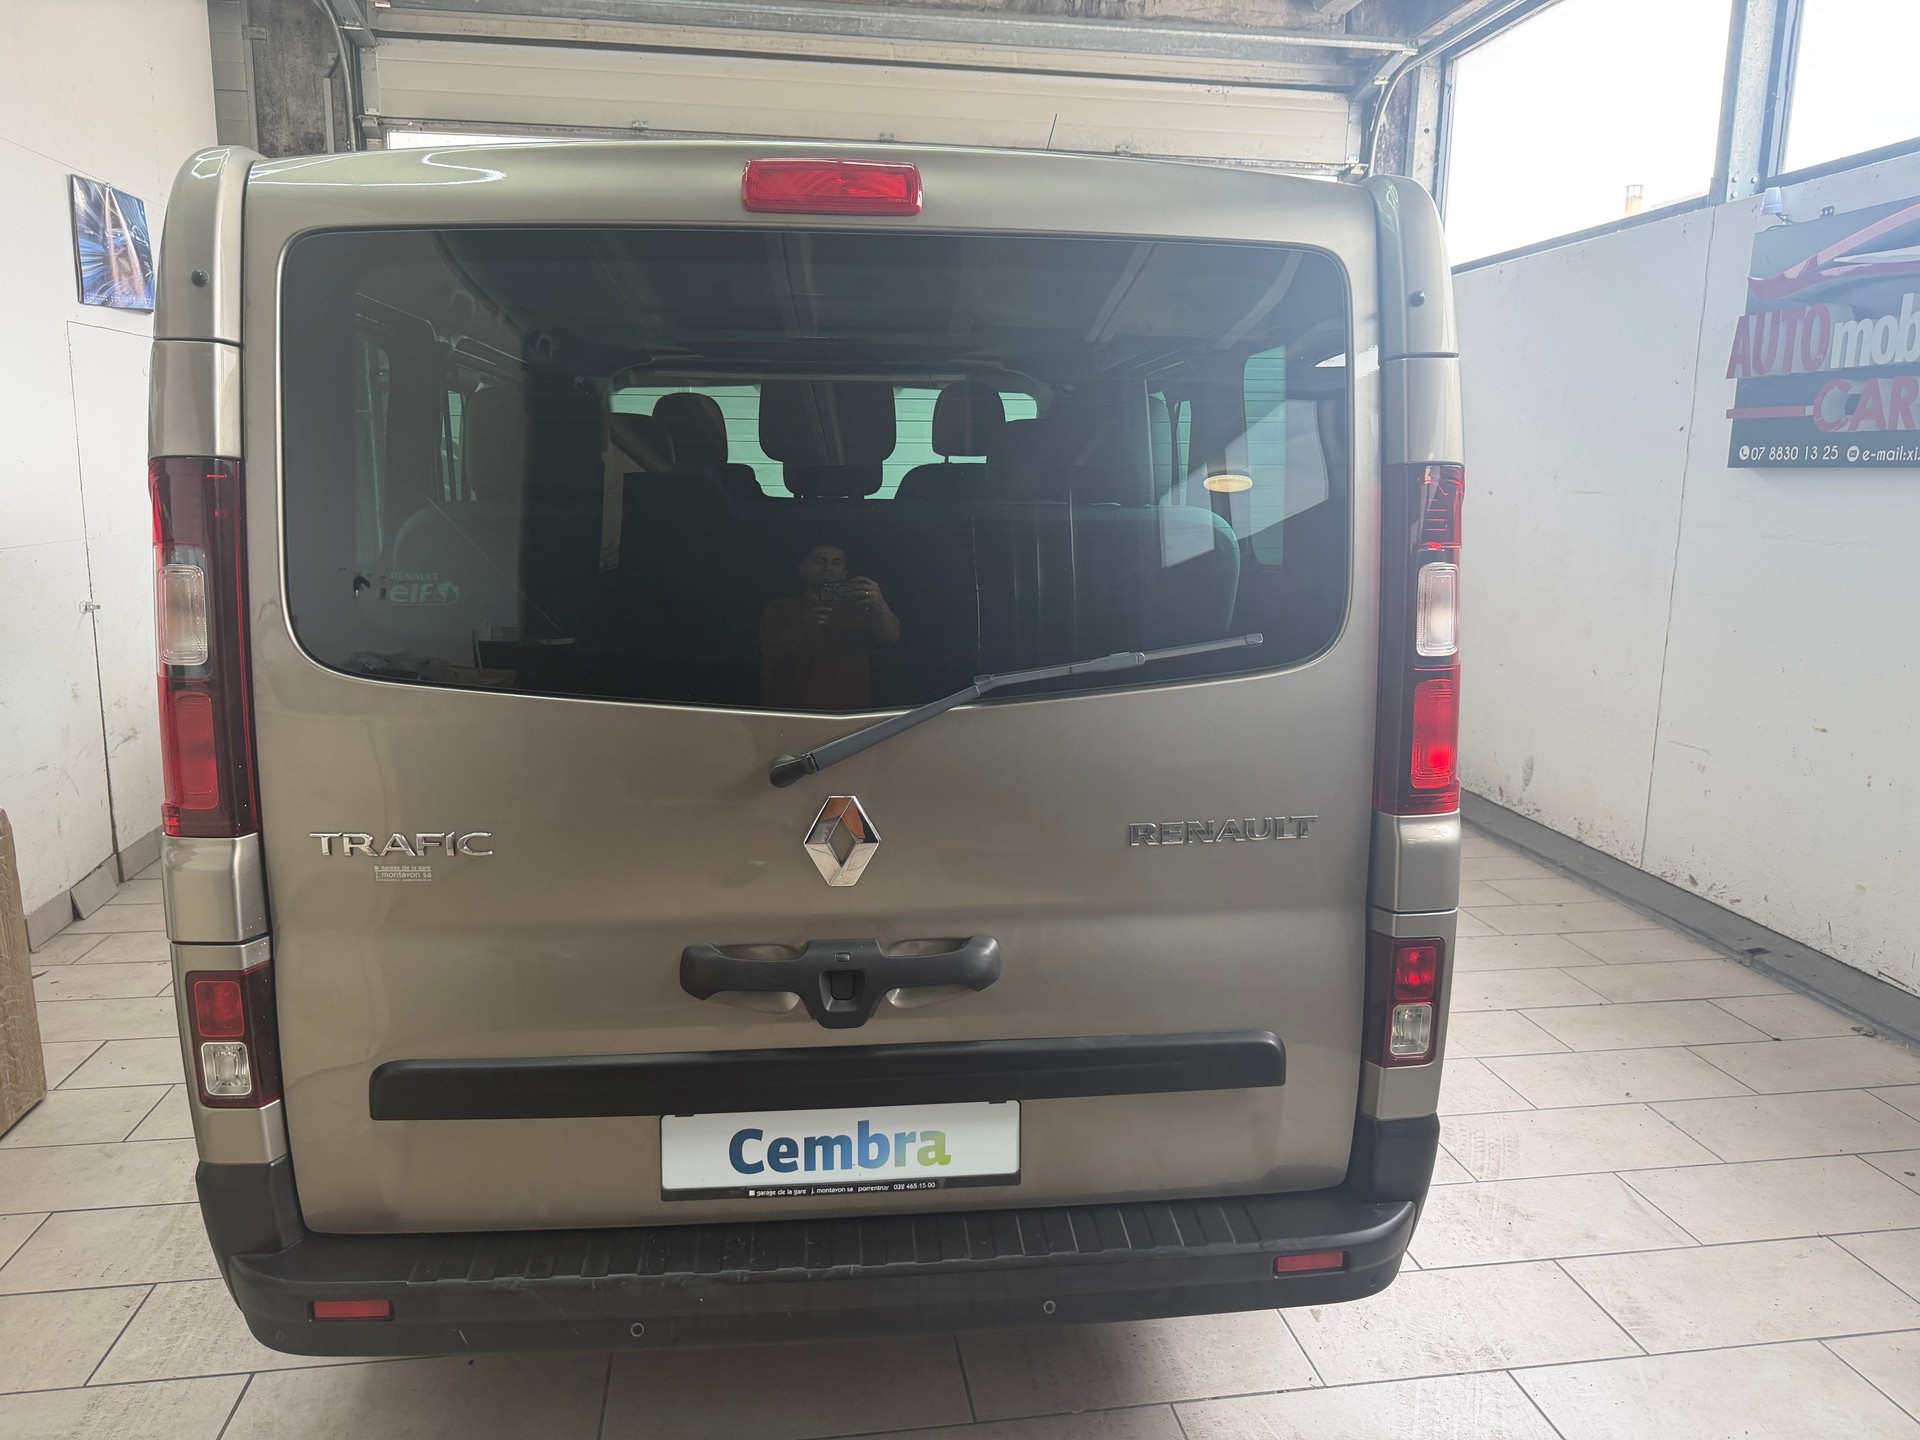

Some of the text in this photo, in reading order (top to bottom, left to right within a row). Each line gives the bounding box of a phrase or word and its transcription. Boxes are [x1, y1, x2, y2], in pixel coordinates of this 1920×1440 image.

[1751, 446, 1765, 460] 07
[1769, 446, 1799, 460] 8830
[1805, 445, 1817, 460] 13
[1823, 445, 1839, 460] 25
[391, 572, 438, 581] RENAULT
[1129, 814, 1318, 846] RENAULT
[309, 831, 494, 857] TRAFIC
[728, 1119, 951, 1175] Cembra
[756, 1189, 776, 1197] garage
[793, 1188, 807, 1196] gare
[816, 1186, 846, 1194] montavon
[857, 1185, 889, 1193] porrentruy
